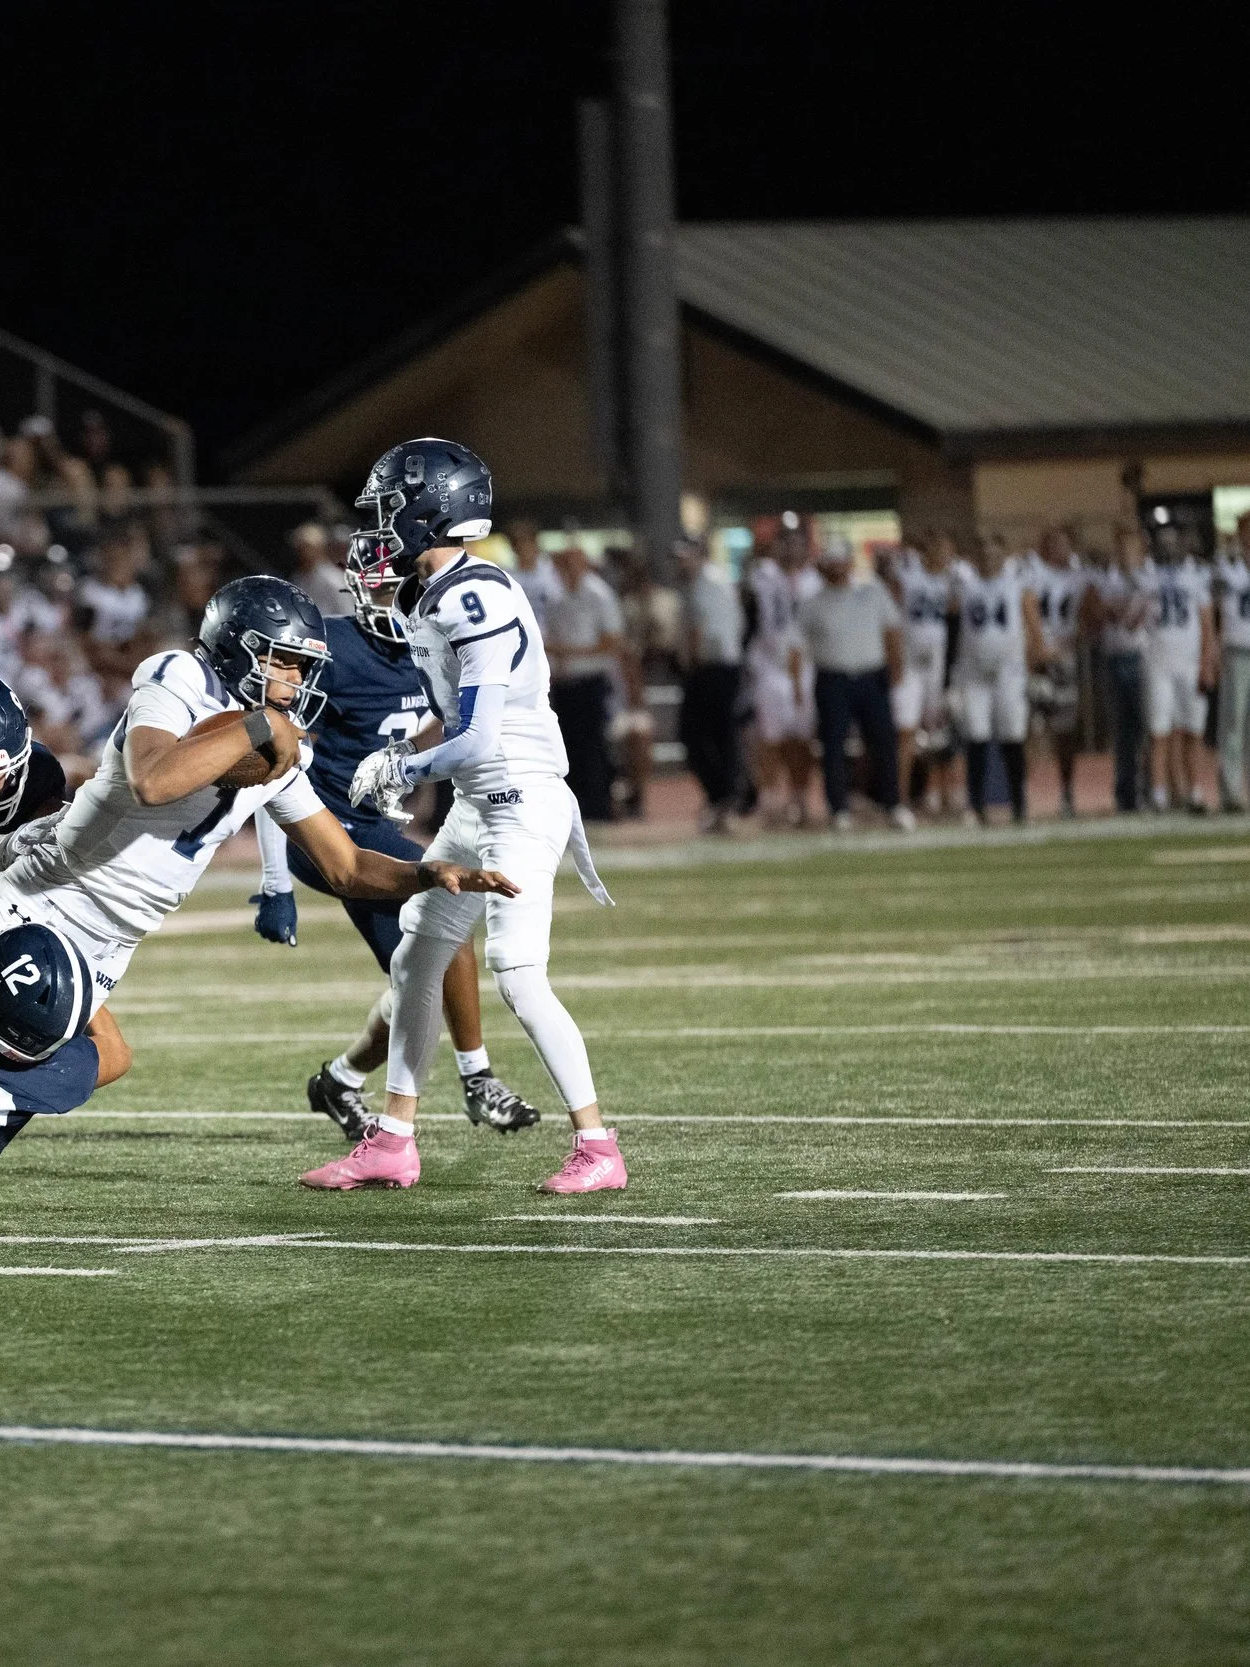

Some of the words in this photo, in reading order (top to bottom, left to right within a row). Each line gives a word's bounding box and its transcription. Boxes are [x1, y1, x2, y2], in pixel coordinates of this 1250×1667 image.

[405, 455, 426, 485] 9
[460, 590, 488, 626] 9
[149, 653, 180, 685] 1
[0, 953, 41, 996] 12
